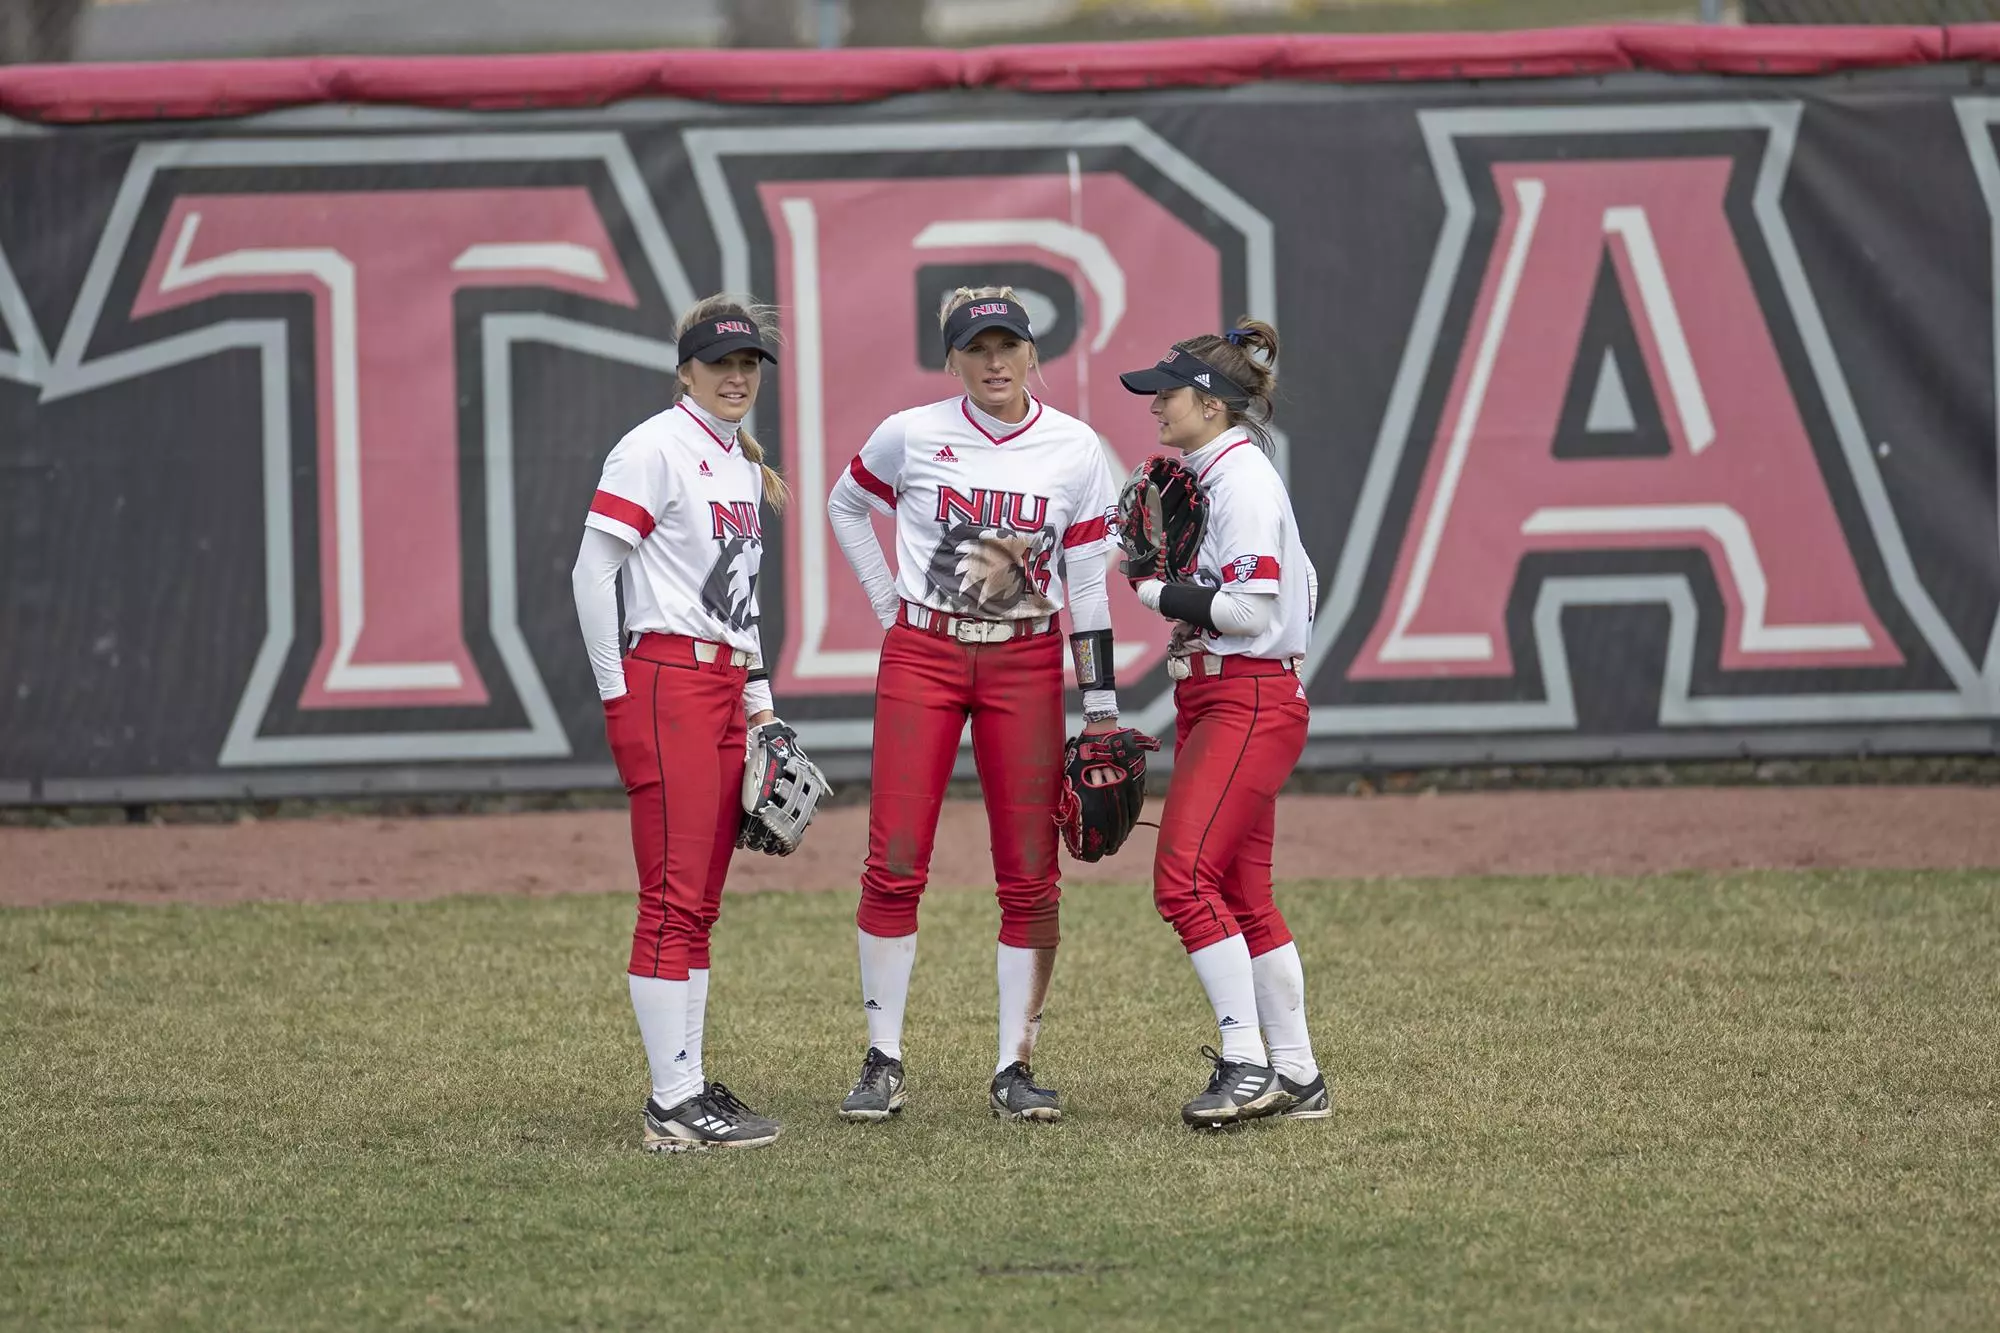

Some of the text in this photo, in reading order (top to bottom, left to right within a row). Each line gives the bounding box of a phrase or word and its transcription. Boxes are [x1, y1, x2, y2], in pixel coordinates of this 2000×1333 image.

[969, 303, 1008, 319] NIU
[715, 321, 752, 335] NIU
[40, 100, 1990, 767] TRA
[935, 485, 1049, 533] NIU
